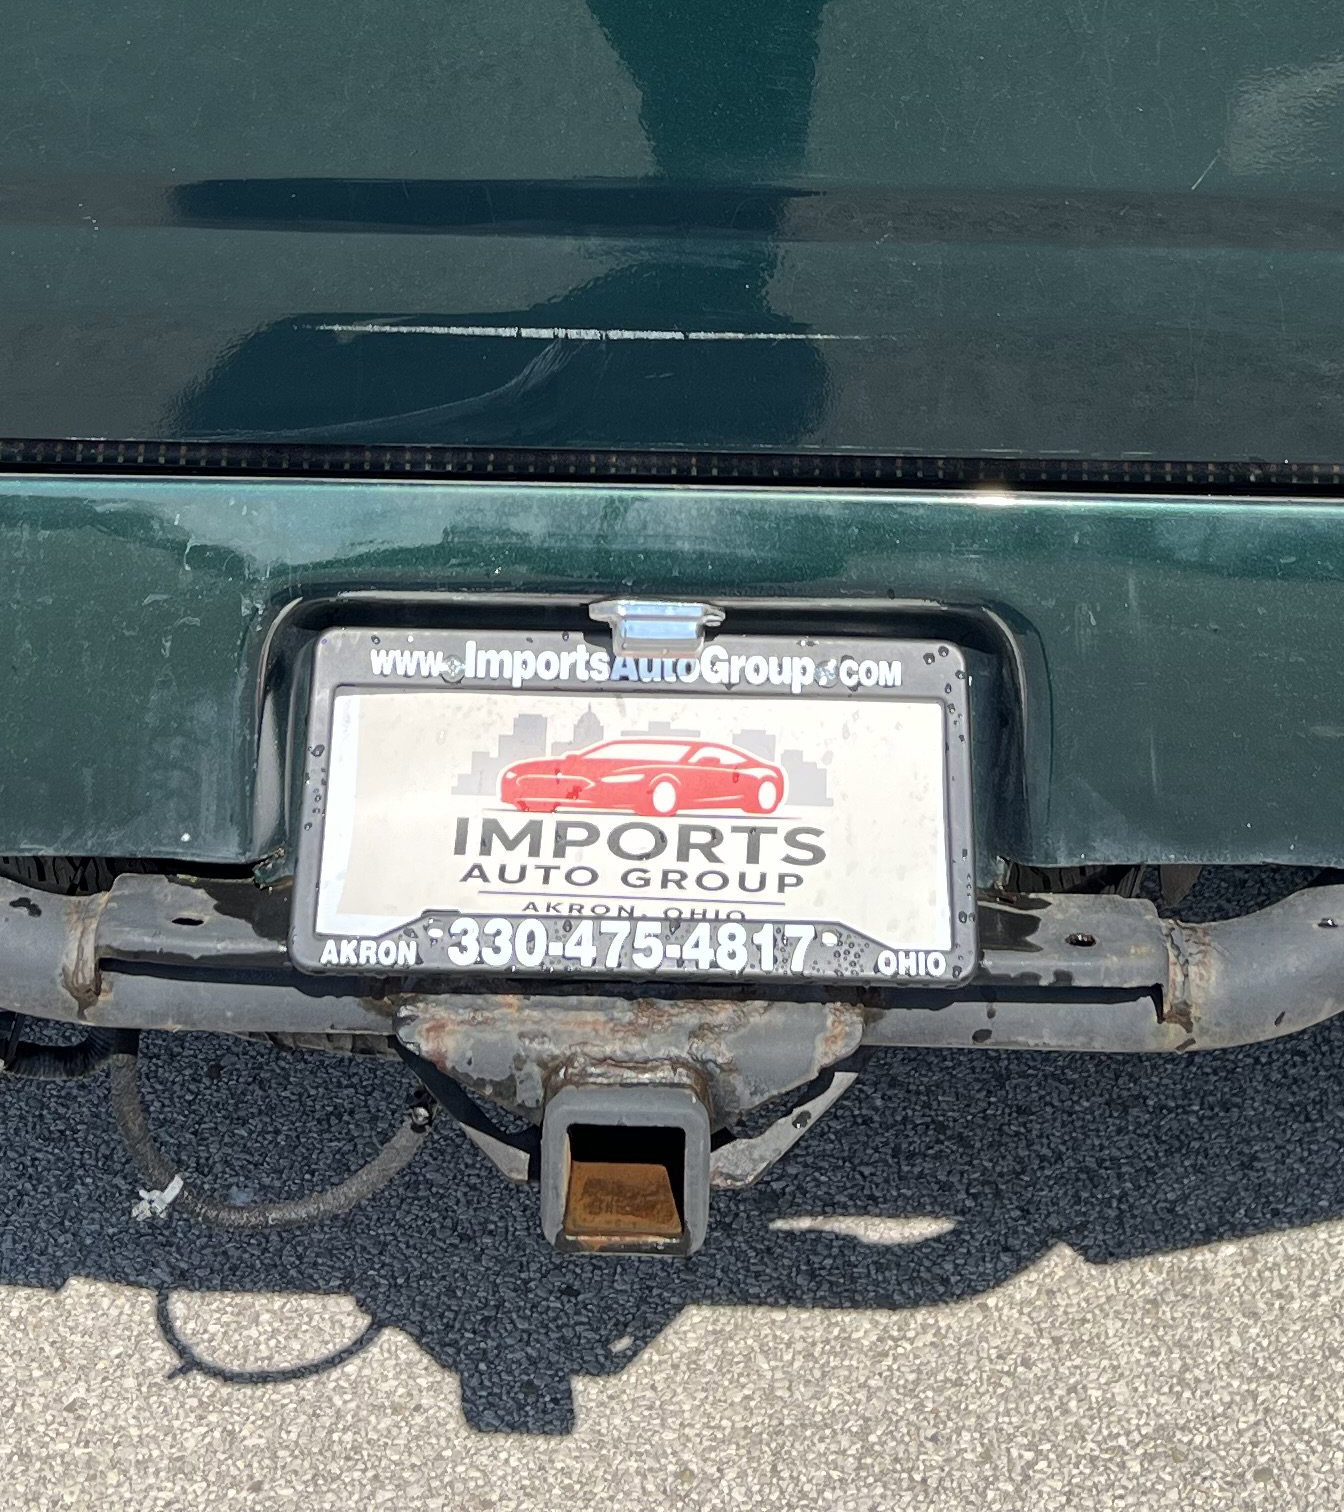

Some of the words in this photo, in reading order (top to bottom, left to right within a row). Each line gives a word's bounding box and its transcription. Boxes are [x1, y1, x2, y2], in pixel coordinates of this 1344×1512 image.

[453, 816, 827, 867] IMPORTS
[459, 863, 600, 887] AUTO
[620, 868, 805, 894] GROUP
[663, 907, 747, 920] OHIO
[320, 939, 417, 966] AKRON
[447, 917, 816, 973] 330-475-4817
[877, 949, 947, 976] OHIO
